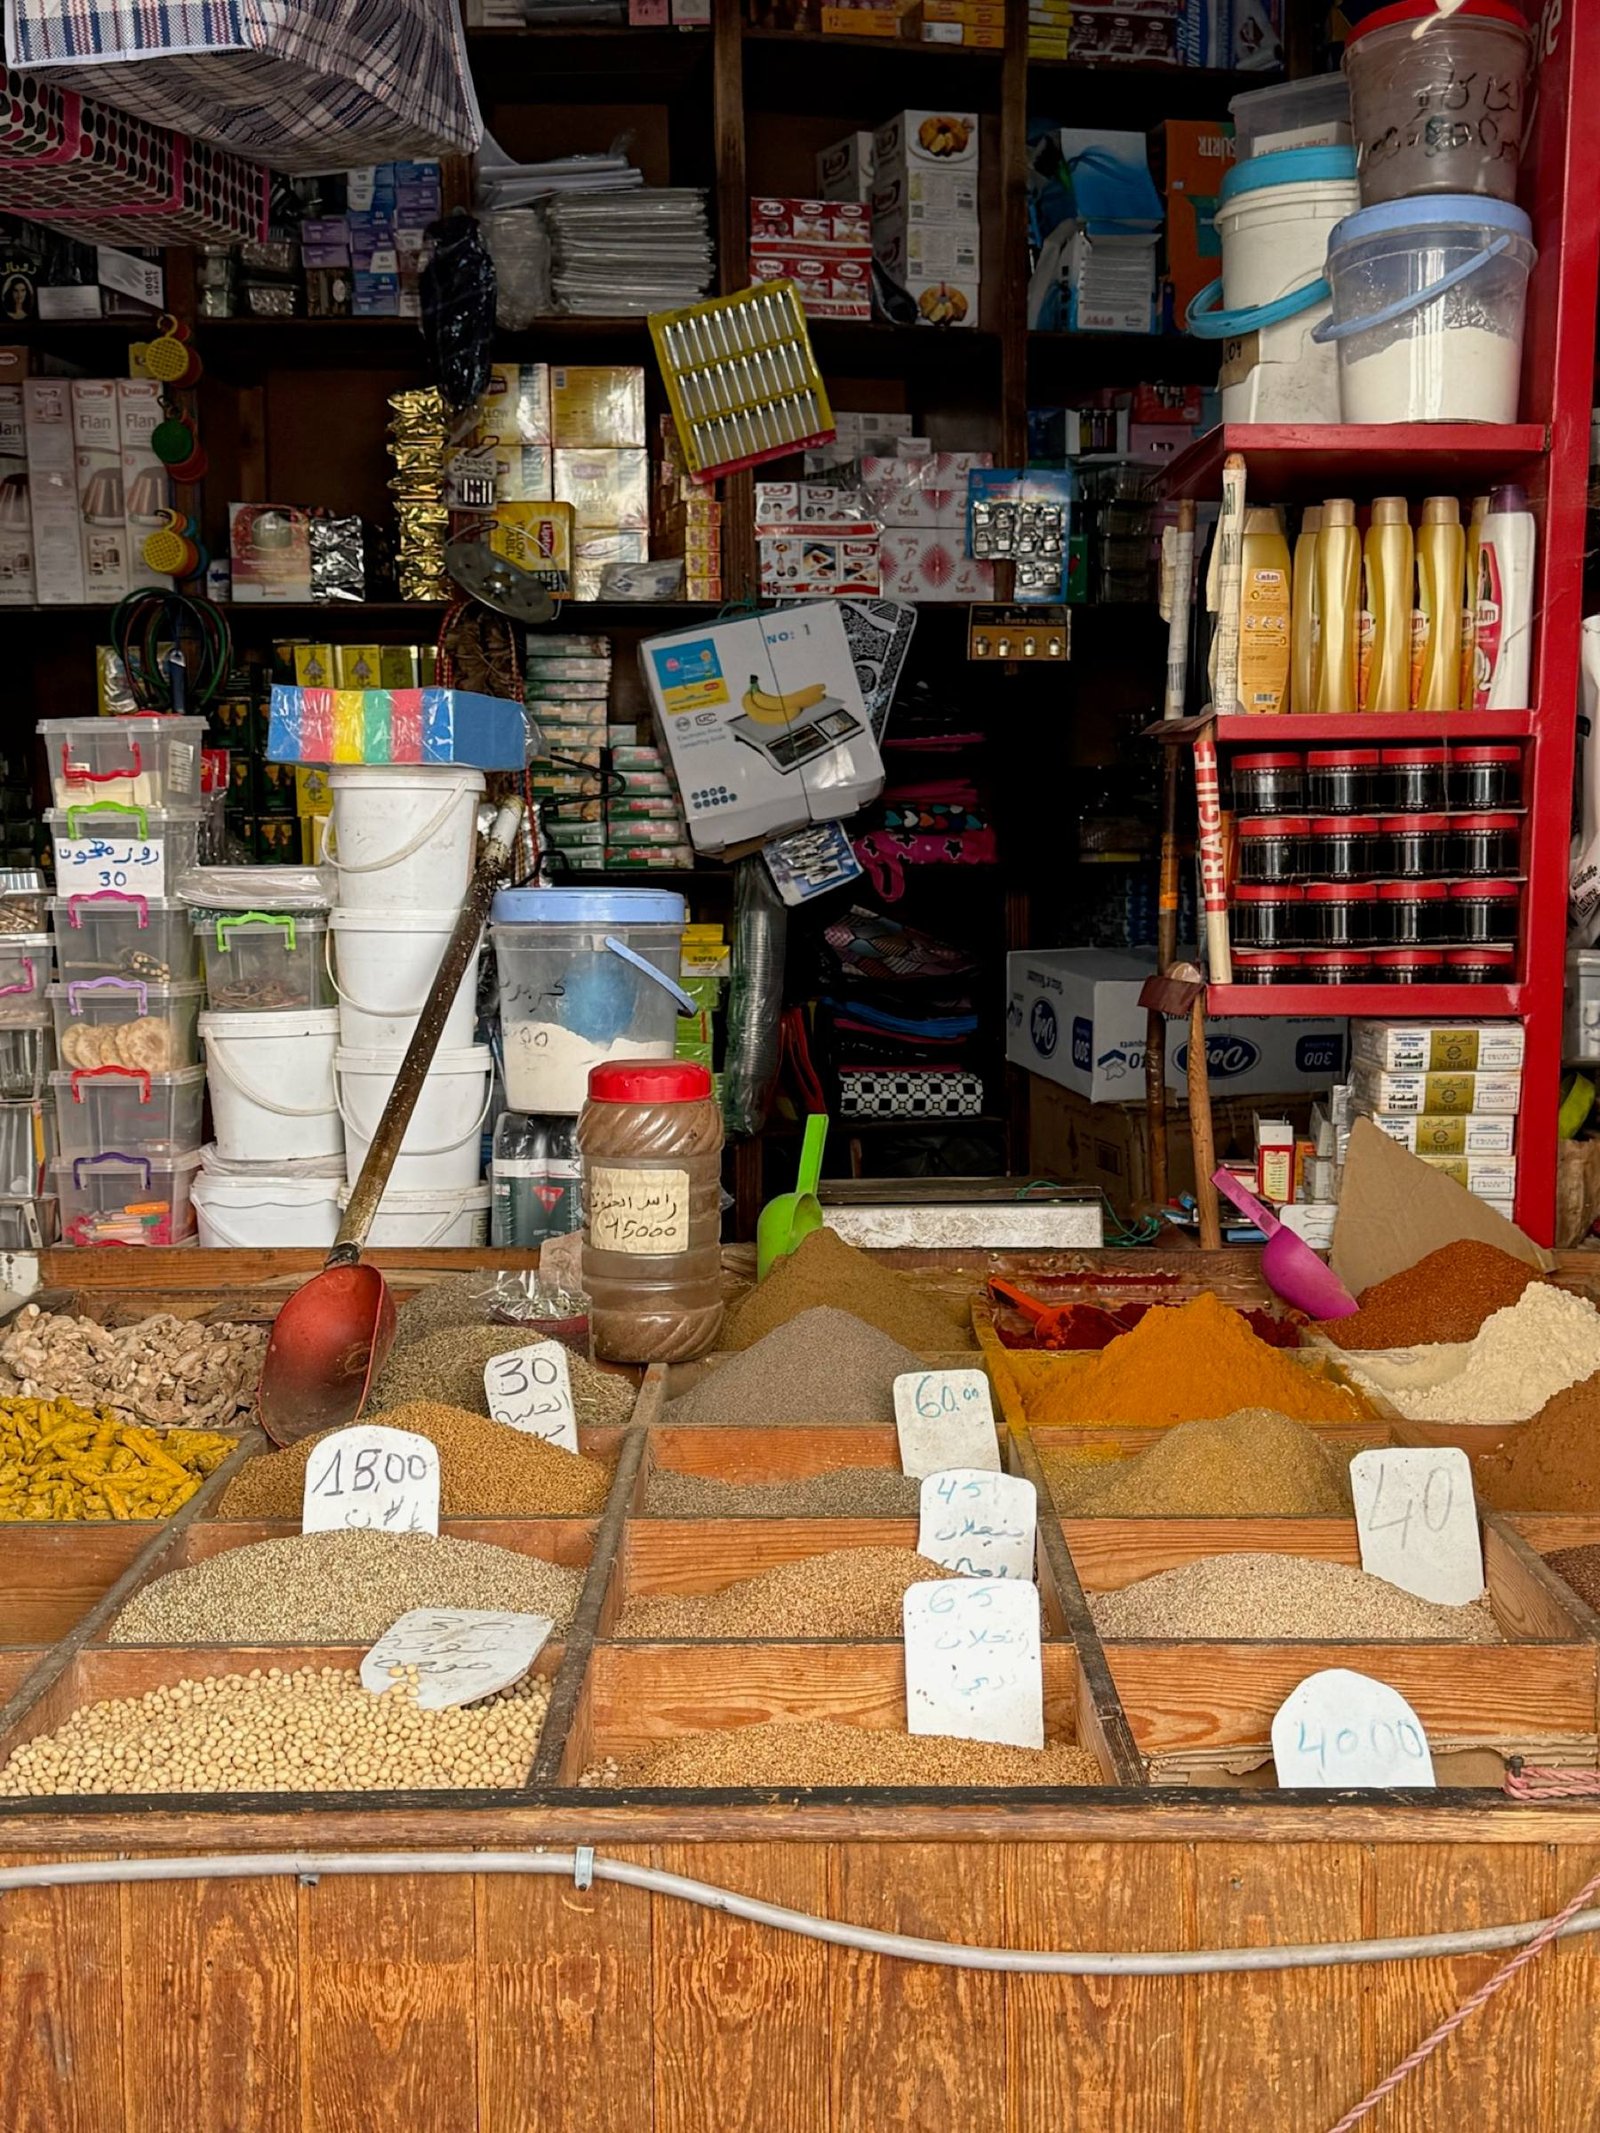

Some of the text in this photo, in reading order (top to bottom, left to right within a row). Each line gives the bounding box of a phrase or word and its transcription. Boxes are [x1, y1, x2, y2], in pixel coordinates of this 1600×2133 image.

[80, 415, 111, 429] Flan
[125, 413, 157, 429] Flan
[516, 519, 526, 561] YELLOW
[540, 523, 553, 556] Lipton
[766, 630, 795, 645] NO:
[1195, 746, 1225, 902] FRAGILE
[98, 870, 127, 887] 30
[1303, 1051, 1334, 1066] 300
[494, 1356, 559, 1397] 30
[1368, 1463, 1453, 1550] 40
[929, 1583, 1002, 1614] 65
[404, 1615, 515, 1634] 30
[1297, 1719, 1425, 1767] 4000
